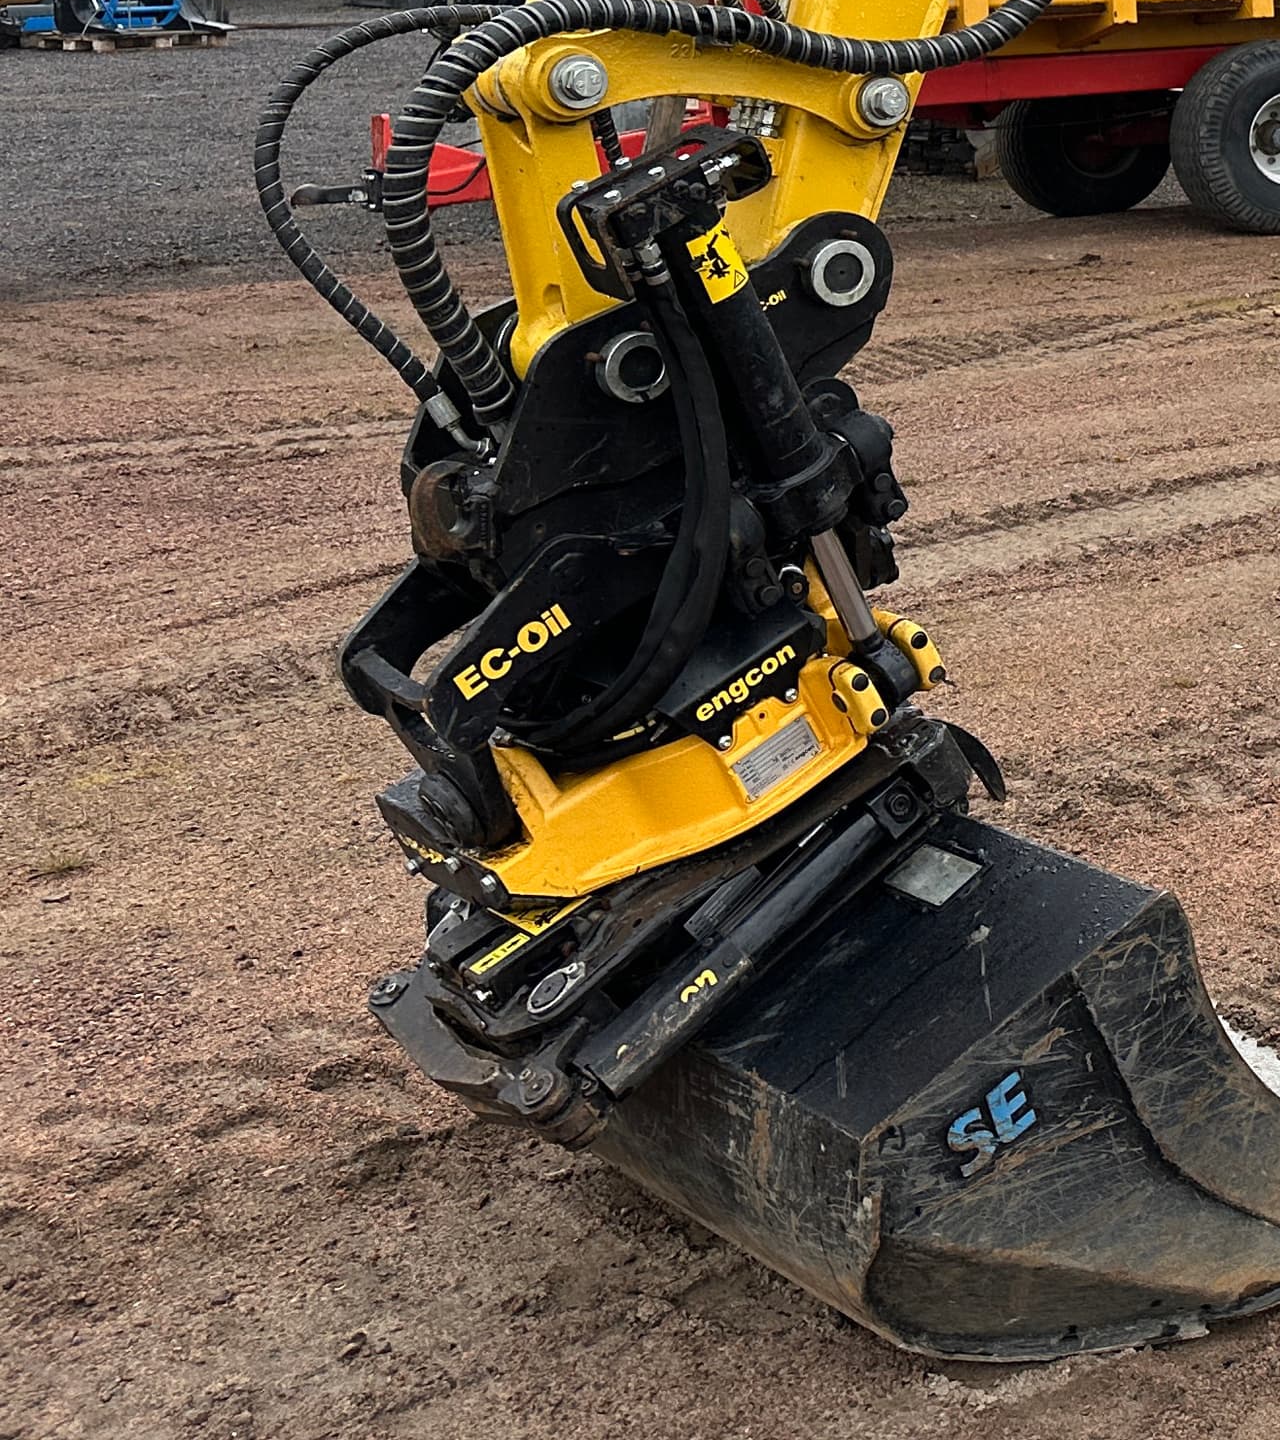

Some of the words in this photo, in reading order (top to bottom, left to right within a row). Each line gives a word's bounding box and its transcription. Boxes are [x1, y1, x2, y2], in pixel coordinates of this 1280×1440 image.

[453, 603, 572, 701] EC-Oil
[696, 644, 796, 722] engcon
[947, 1071, 1037, 1178] SE
